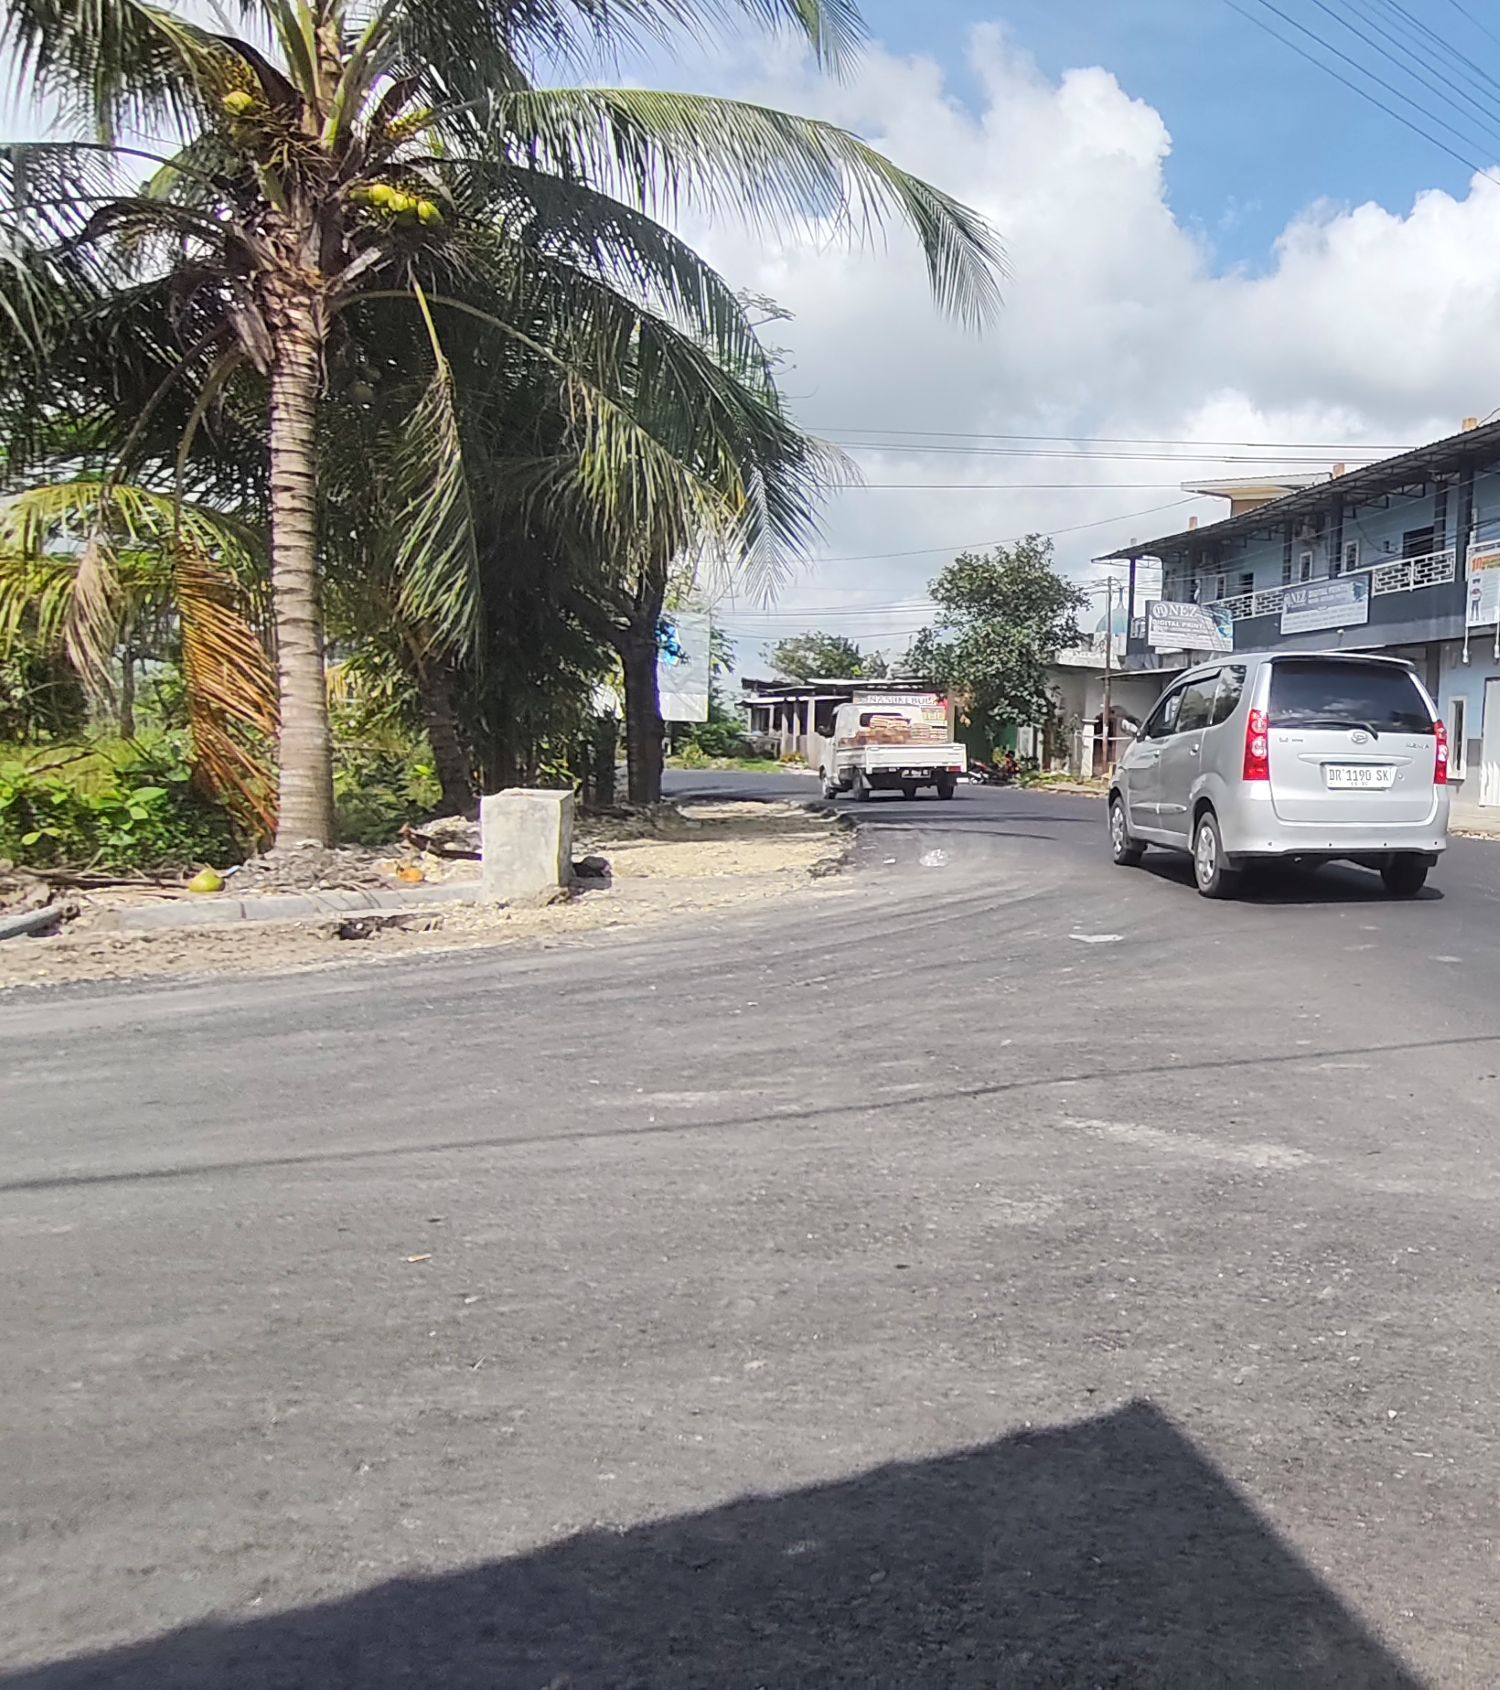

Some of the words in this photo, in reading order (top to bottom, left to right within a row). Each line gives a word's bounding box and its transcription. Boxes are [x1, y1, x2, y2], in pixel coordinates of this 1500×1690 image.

[1169, 605, 1197, 617] NEZ
[1152, 619, 1179, 627] DIGITAL
[1329, 769, 1342, 781] DR
[1346, 769, 1372, 781] 1190
[1377, 770, 1389, 781] SK
